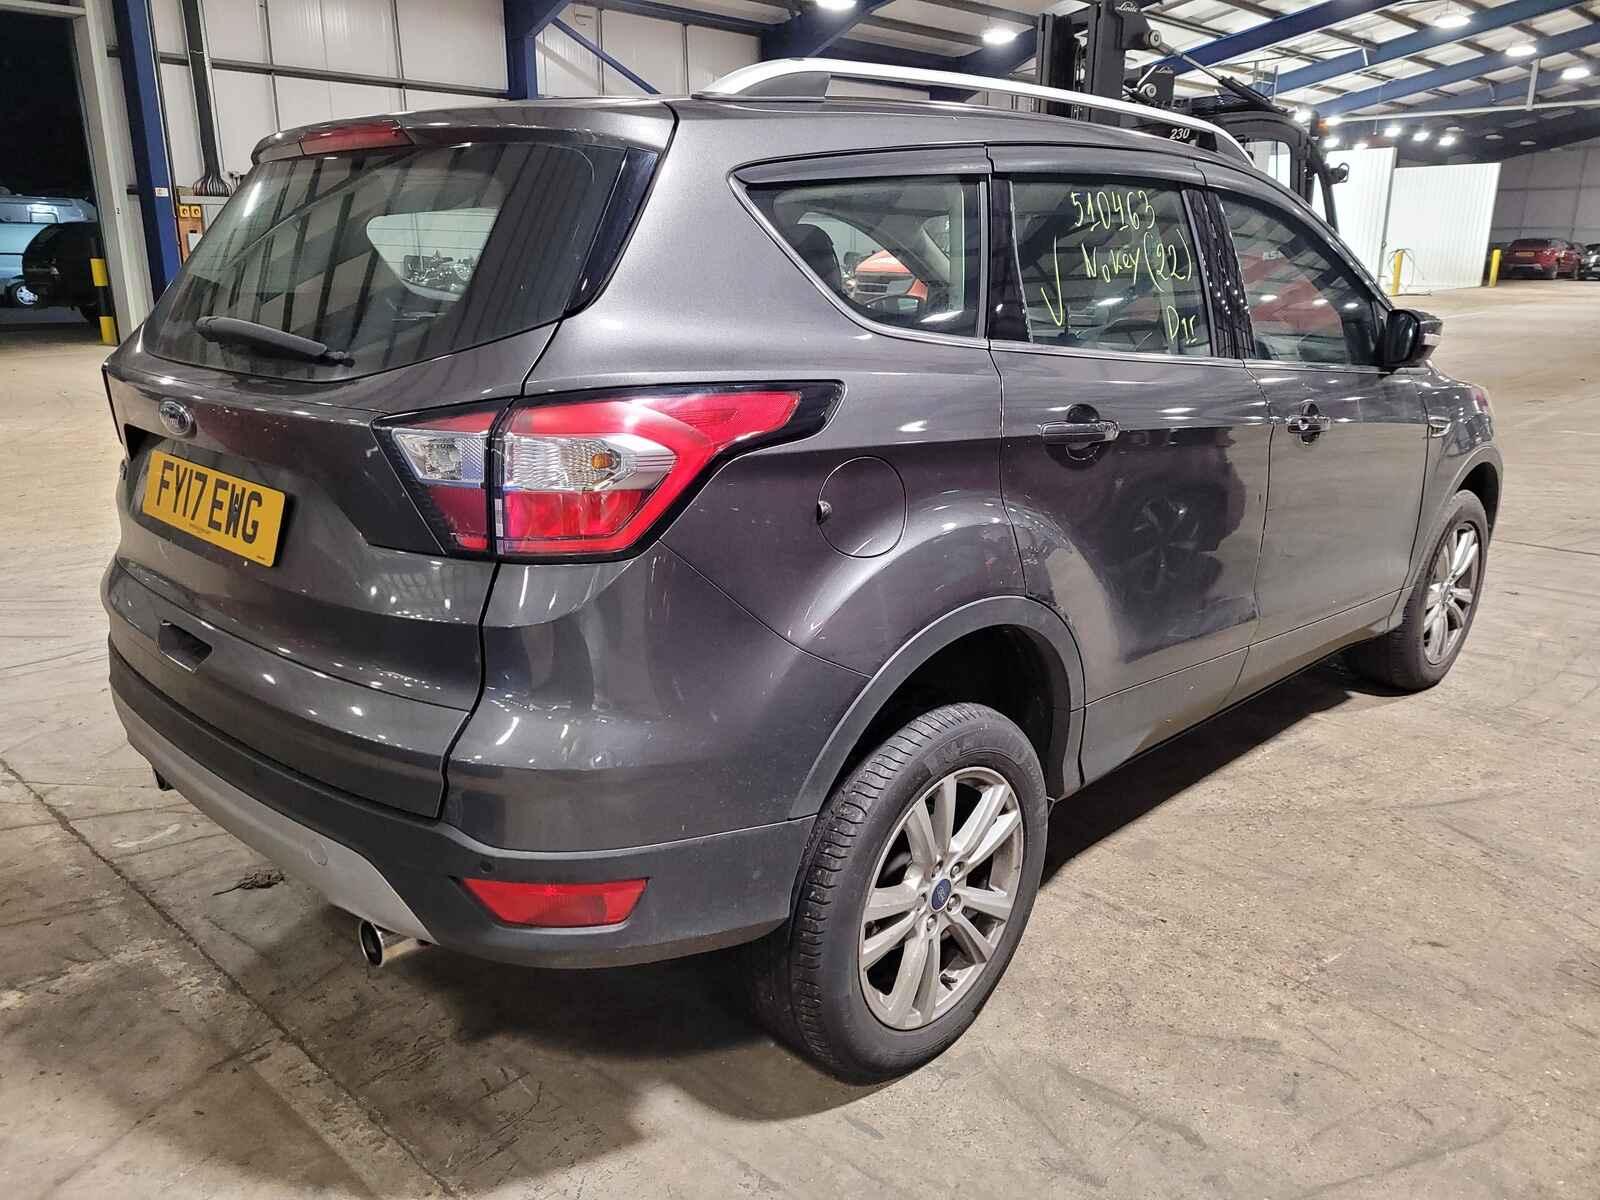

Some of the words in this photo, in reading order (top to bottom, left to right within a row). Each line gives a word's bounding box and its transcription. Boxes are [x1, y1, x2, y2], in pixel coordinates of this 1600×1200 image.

[1115, 1, 1138, 13] Linde
[1169, 128, 1190, 140] 230
[1070, 190, 1155, 231] 510463
[156, 460, 208, 521] FY17
[208, 478, 263, 544] EWG
